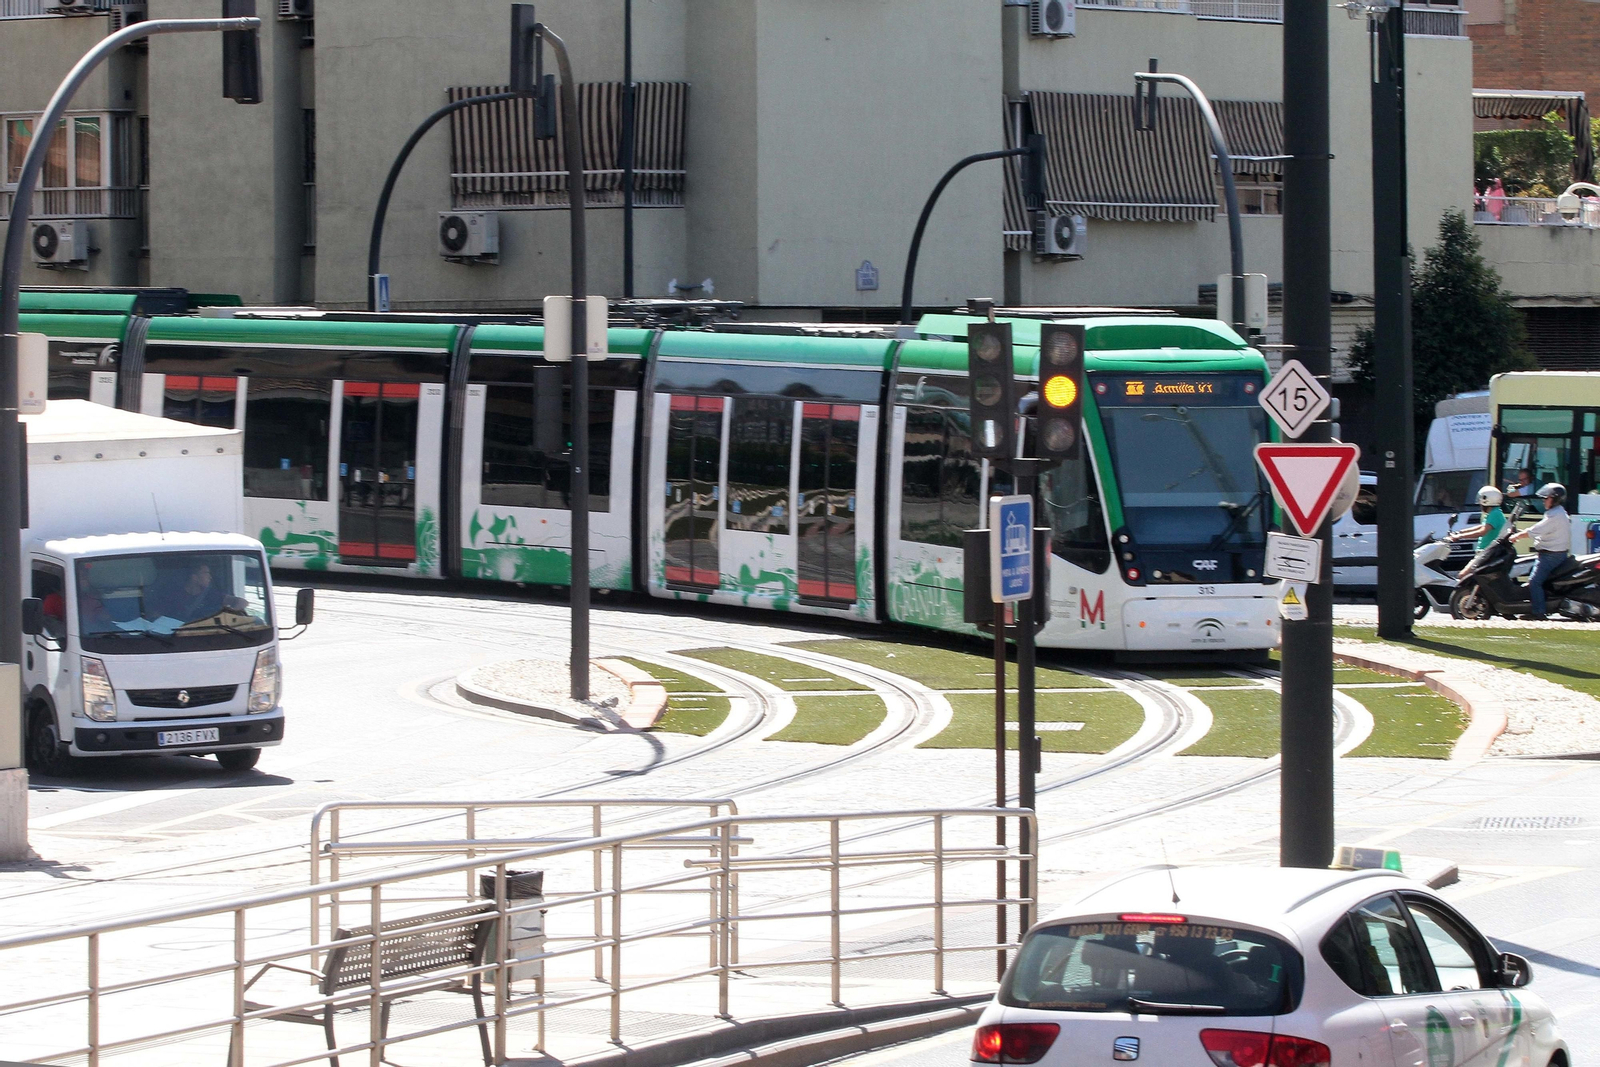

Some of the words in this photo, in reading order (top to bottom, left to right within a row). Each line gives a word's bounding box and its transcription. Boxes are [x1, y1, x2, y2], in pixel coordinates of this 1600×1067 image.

[1279, 387, 1307, 411] 15
[1198, 586, 1216, 595] 313
[1080, 588, 1106, 630] M
[166, 731, 193, 744] 2136
[196, 730, 216, 741] FVX
[1101, 923, 1123, 935] TAXI
[1169, 924, 1189, 938] 958
[1191, 926, 1204, 938] 13
